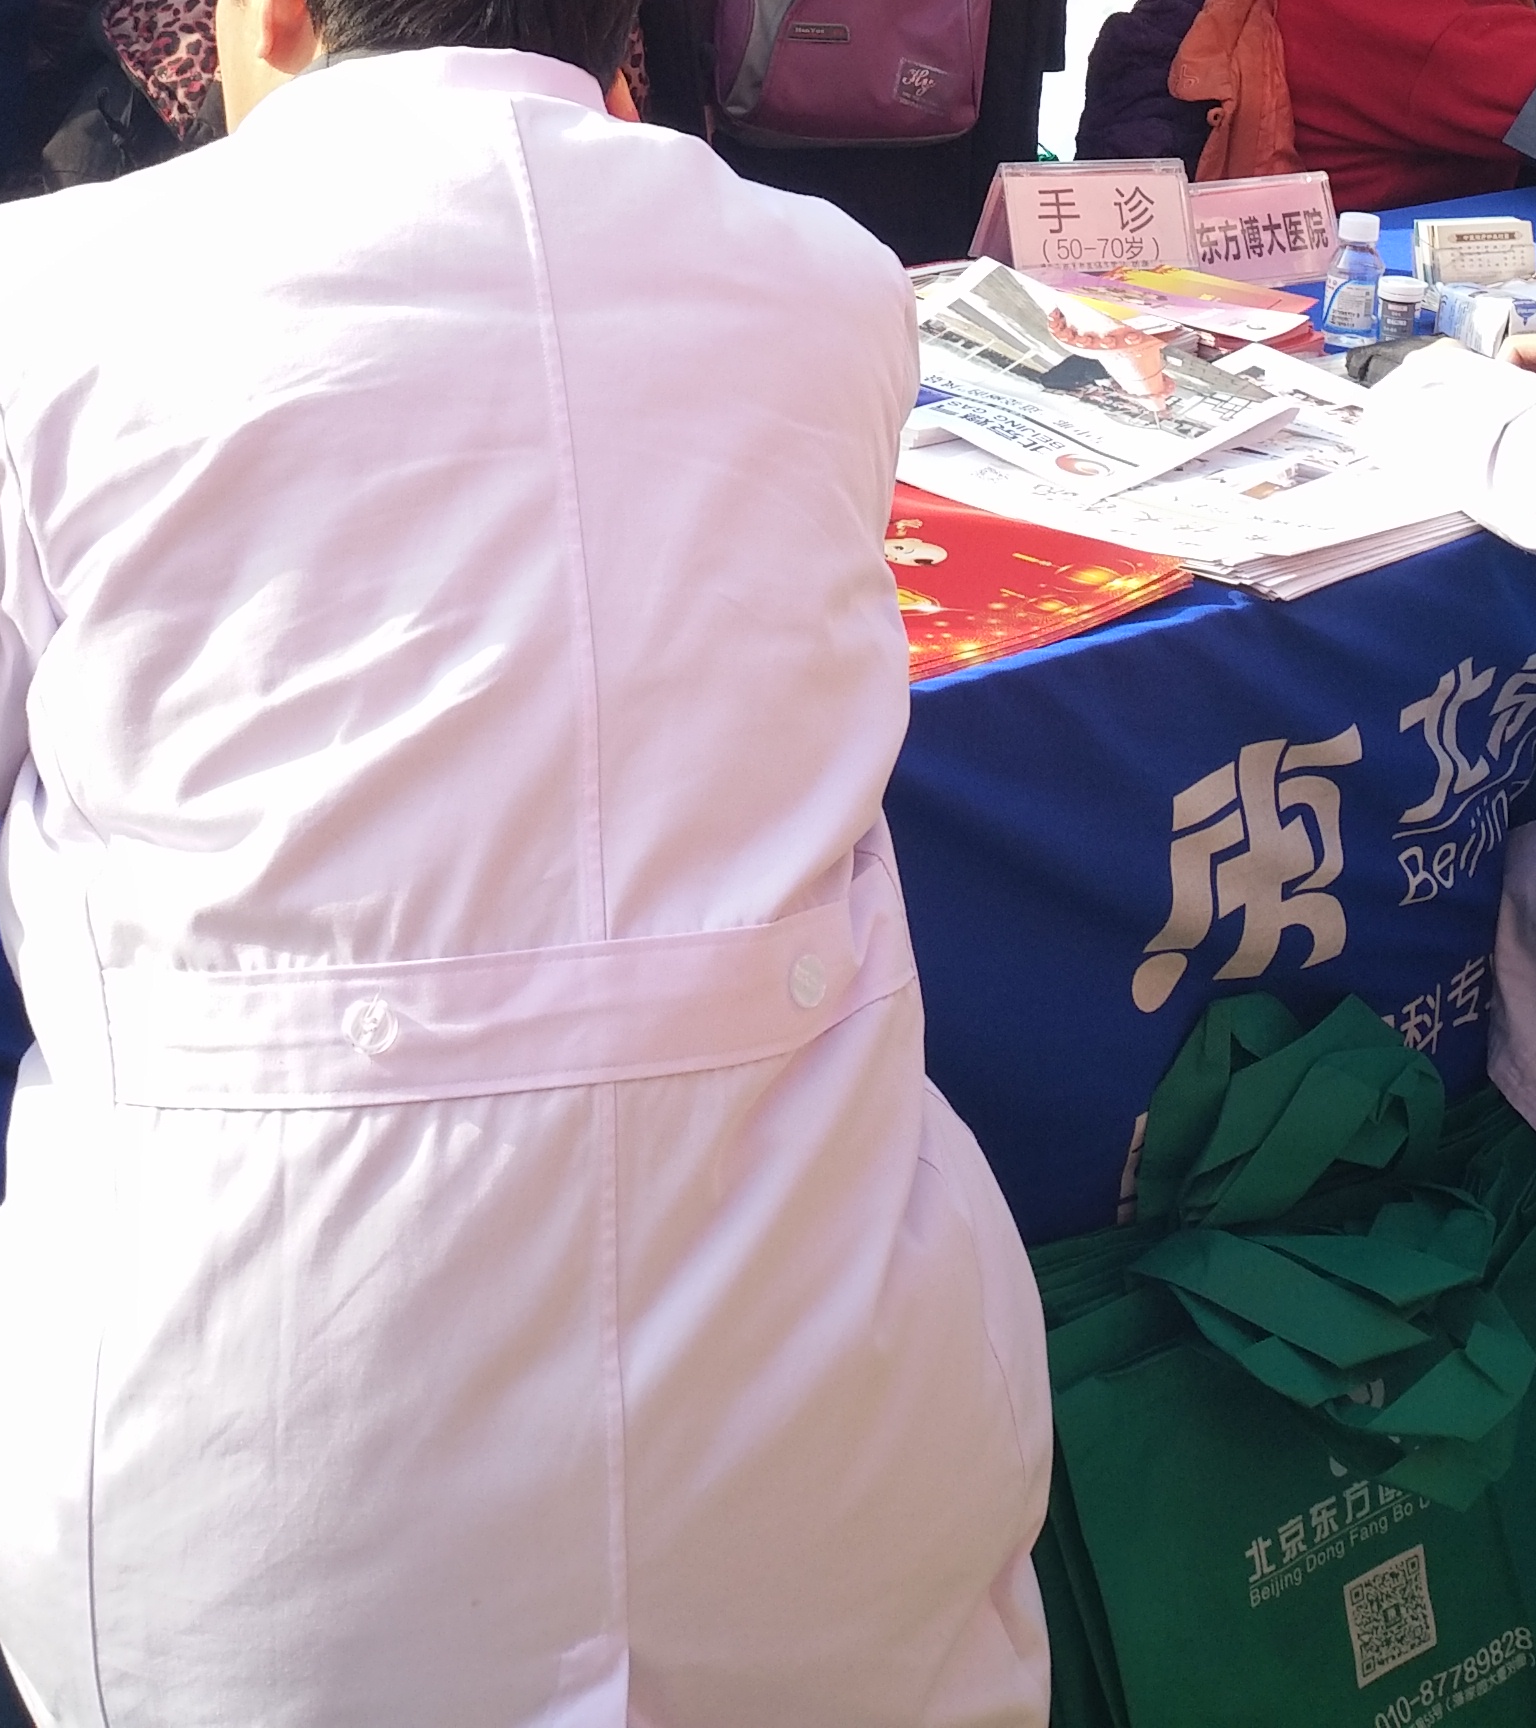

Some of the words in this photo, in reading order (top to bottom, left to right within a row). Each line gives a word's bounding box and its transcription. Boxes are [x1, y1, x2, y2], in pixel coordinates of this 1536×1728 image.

[1038, 186, 1156, 234] 手诊
[1042, 236, 1161, 261] （50-70岁）
[1196, 208, 1329, 264] 东方博大医院
[948, 399, 990, 415] GAS
[994, 412, 1066, 450] BEIJING
[1250, 1566, 1302, 1608] Beijing
[1306, 1540, 1346, 1573] Dong
[1349, 1515, 1389, 1547] Fang
[1392, 1501, 1413, 1523] Bo
[1375, 1627, 1533, 1728] 010-87789828
